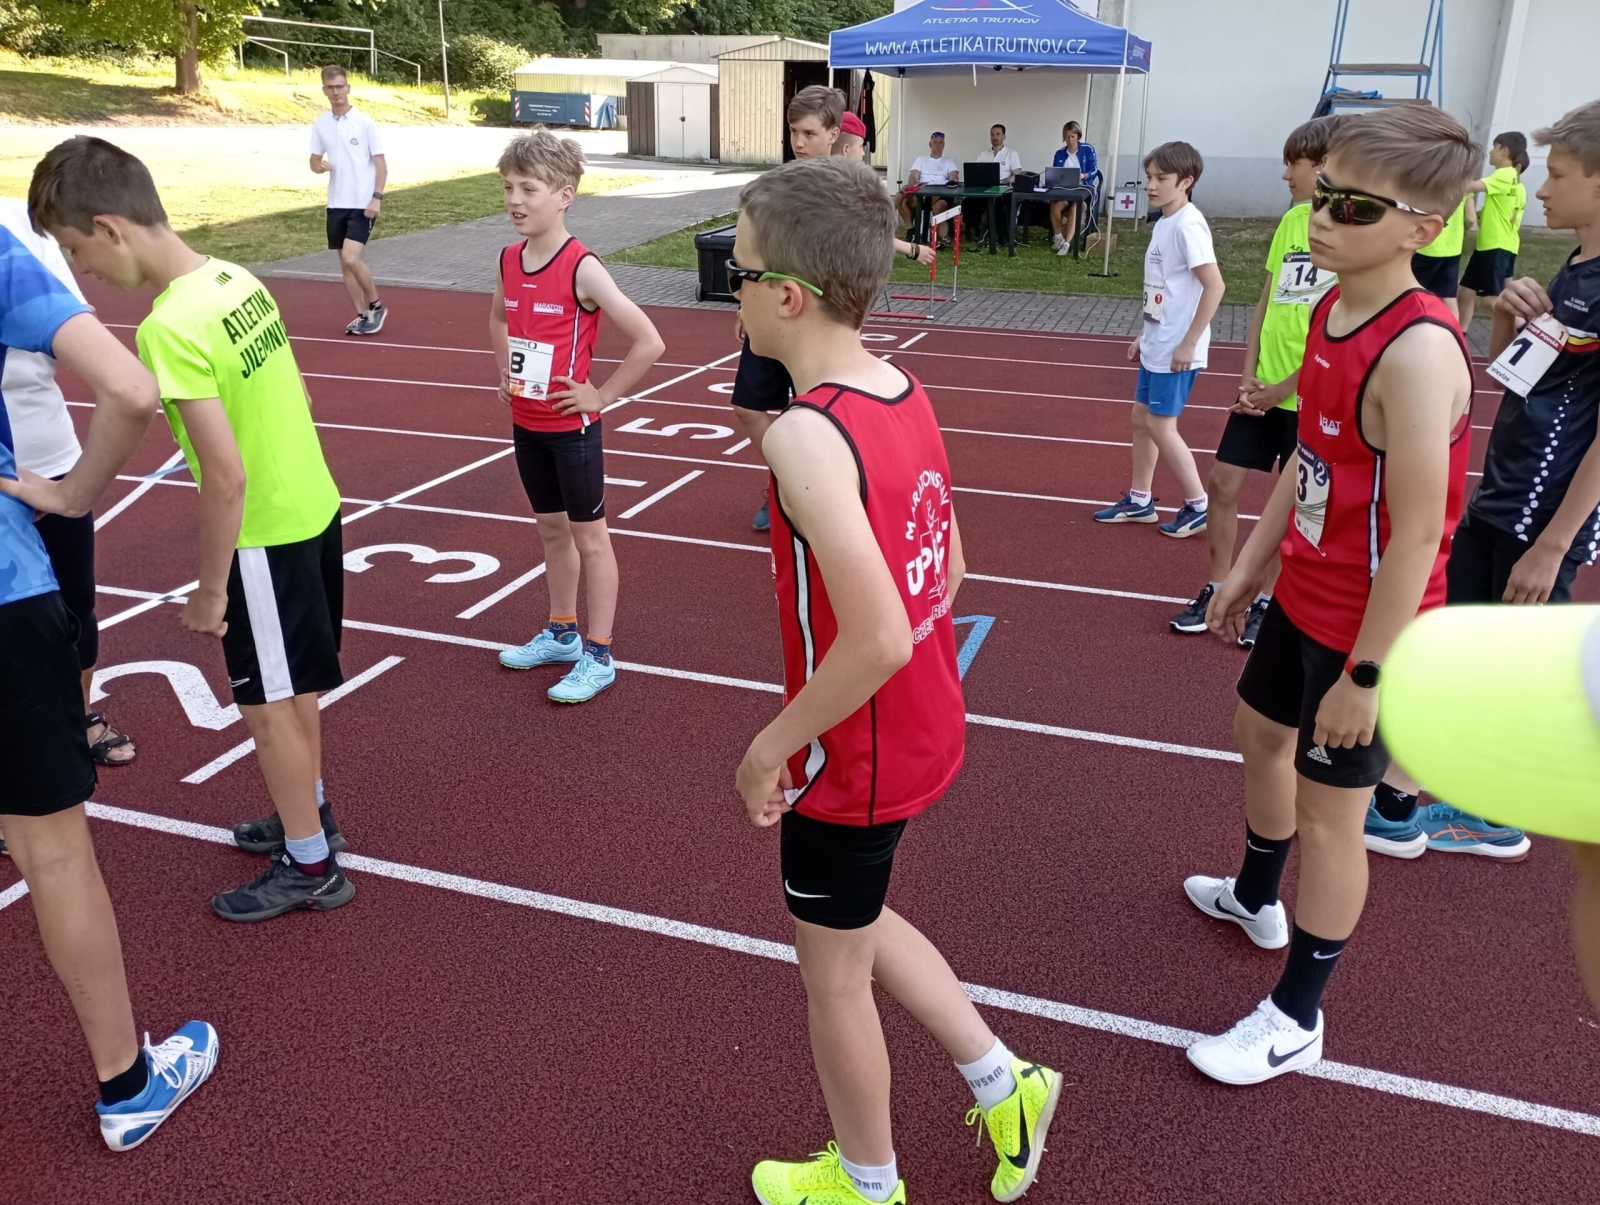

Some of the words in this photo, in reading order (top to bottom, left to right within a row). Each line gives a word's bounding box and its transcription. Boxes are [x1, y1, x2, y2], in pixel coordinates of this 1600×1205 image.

[982, 16, 1040, 24] TRUTNOV
[865, 36, 1087, 55] WWW.ATLETIKATRUTNOV.CZ
[1295, 264, 1318, 286] 14
[221, 288, 276, 345] ATLETIK
[239, 317, 287, 379] JILEMNI
[1508, 337, 1533, 366] 1
[510, 351, 525, 374] 8
[614, 417, 735, 440] 5
[1297, 463, 1308, 502] 3
[1315, 461, 1325, 484] 2
[343, 543, 500, 583] 3
[1307, 751, 1332, 765] adidas
[312, 874, 338, 896] salomon
